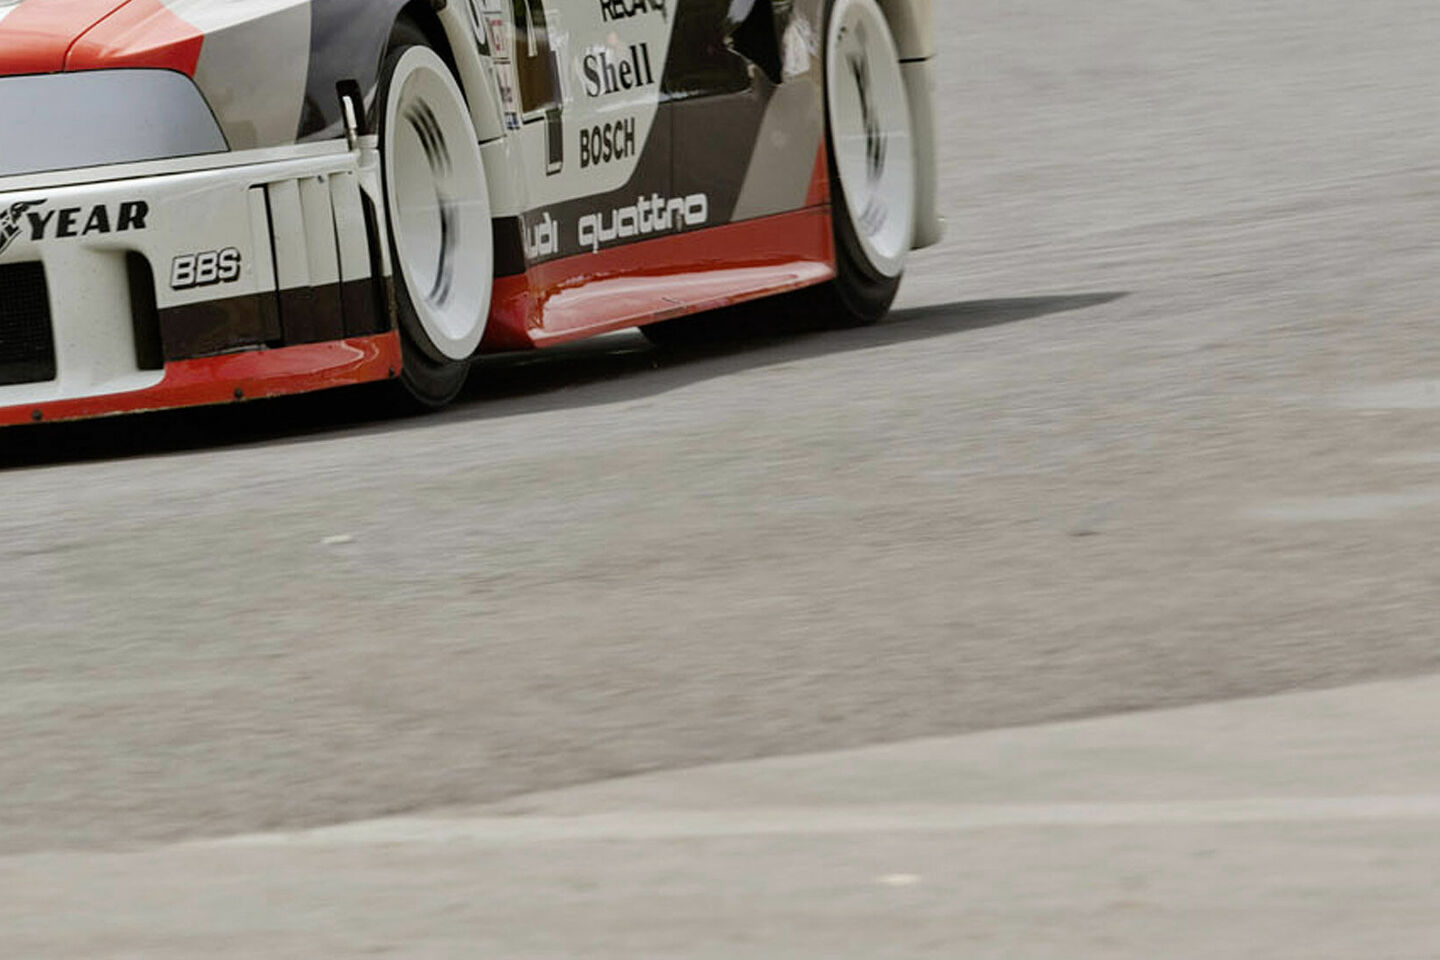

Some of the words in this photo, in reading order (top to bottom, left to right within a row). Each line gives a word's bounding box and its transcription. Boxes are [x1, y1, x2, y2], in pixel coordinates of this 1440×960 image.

[583, 43, 654, 97] Shell
[580, 117, 636, 168] BOSCH
[578, 193, 708, 254] quattro
[169, 246, 242, 290] BBS
